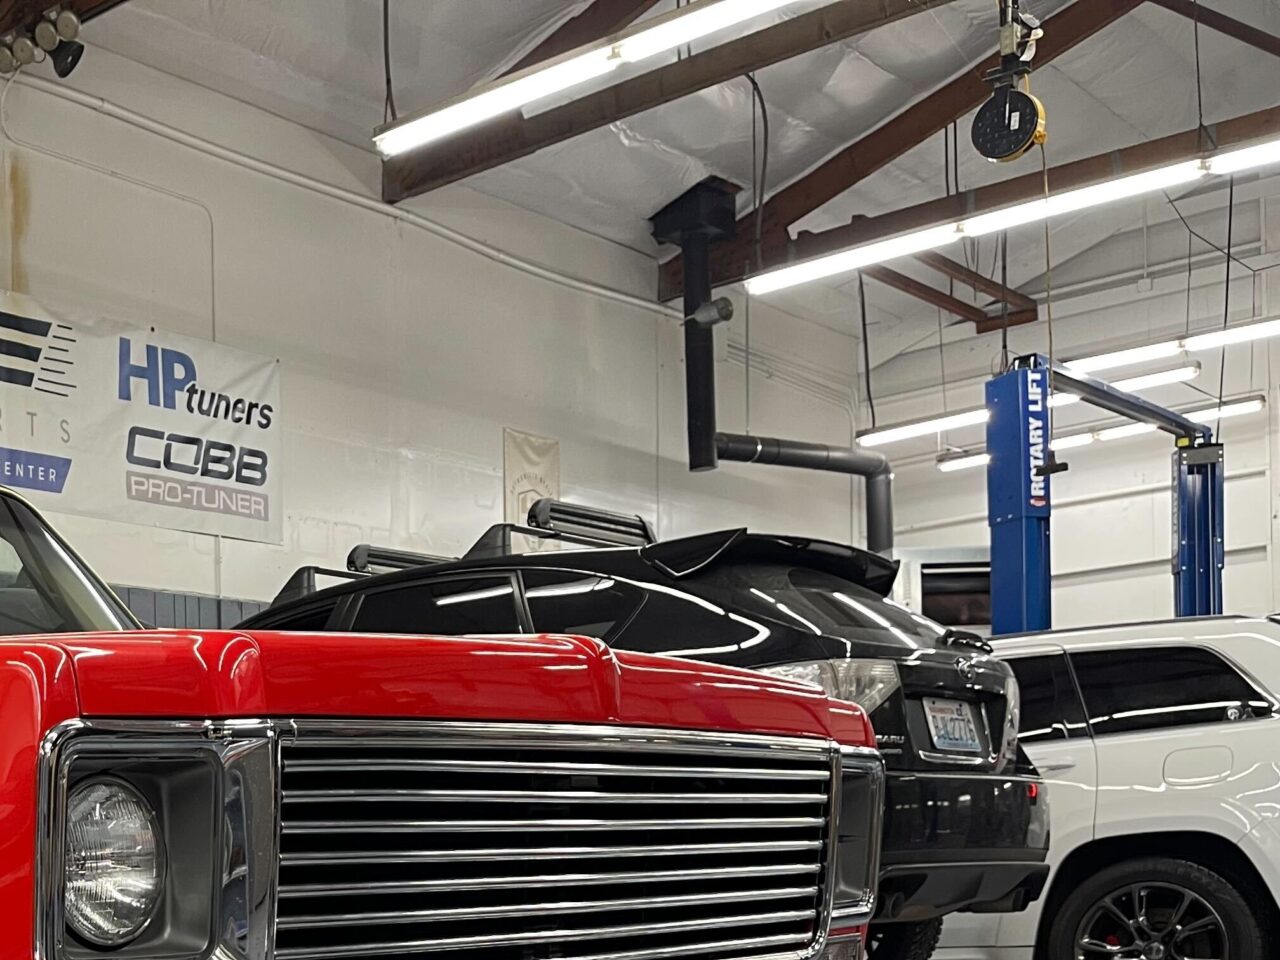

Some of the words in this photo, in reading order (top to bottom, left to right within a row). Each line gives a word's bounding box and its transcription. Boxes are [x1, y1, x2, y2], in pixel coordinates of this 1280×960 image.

[1027, 370, 1043, 412] LIFT
[126, 426, 268, 487] COBB
[1028, 417, 1045, 496] ROTARY
[130, 475, 265, 518] PRO-TUNER
